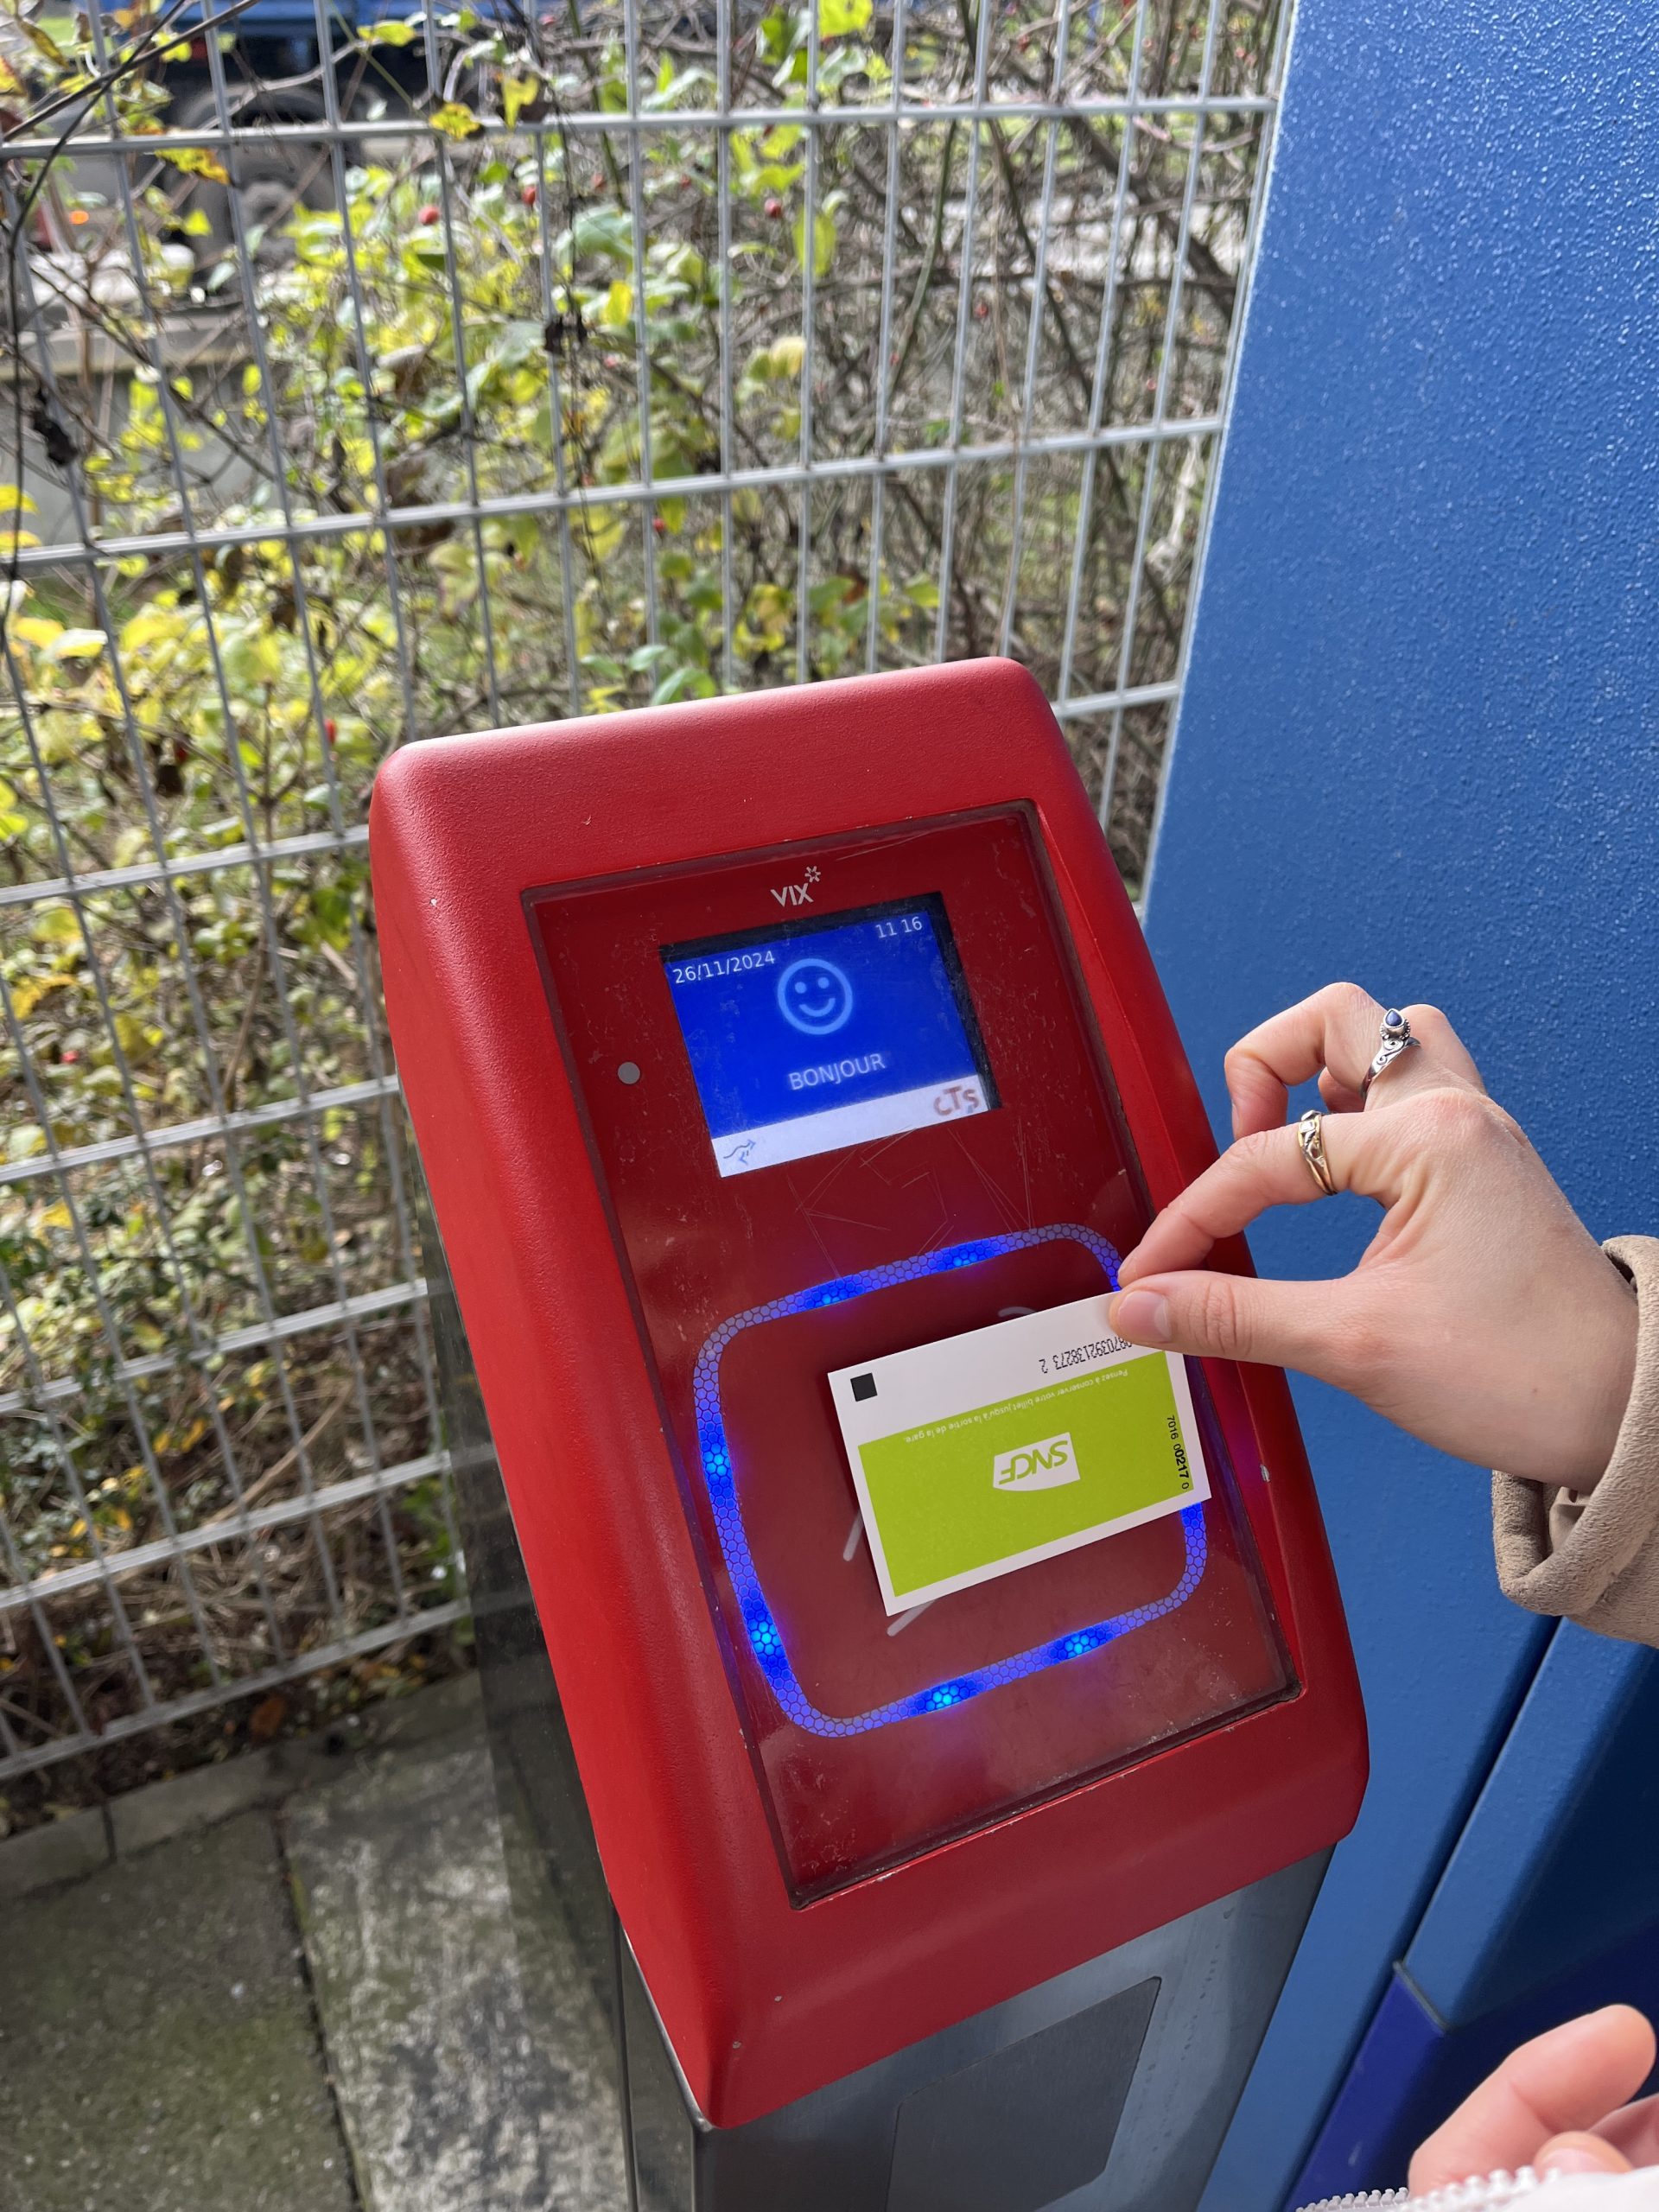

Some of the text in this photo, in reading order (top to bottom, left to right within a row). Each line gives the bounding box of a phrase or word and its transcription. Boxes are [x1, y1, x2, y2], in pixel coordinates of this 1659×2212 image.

[875, 916, 922, 939] 11 16
[672, 950, 776, 985] 26/11/2024
[788, 1053, 886, 1091] BONJOUR
[1102, 1369, 1128, 1381] Pensez
[1057, 1379, 1094, 1395] conserver
[1013, 1397, 1034, 1412] billet
[1035, 1392, 1056, 1403] votre
[936, 1425, 947, 1435] de
[948, 1418, 973, 1429] sortie
[1166, 1414, 1179, 1440] 7016
[1173, 1443, 1189, 1478] 00217
[999, 1440, 1068, 1485] SNCF
